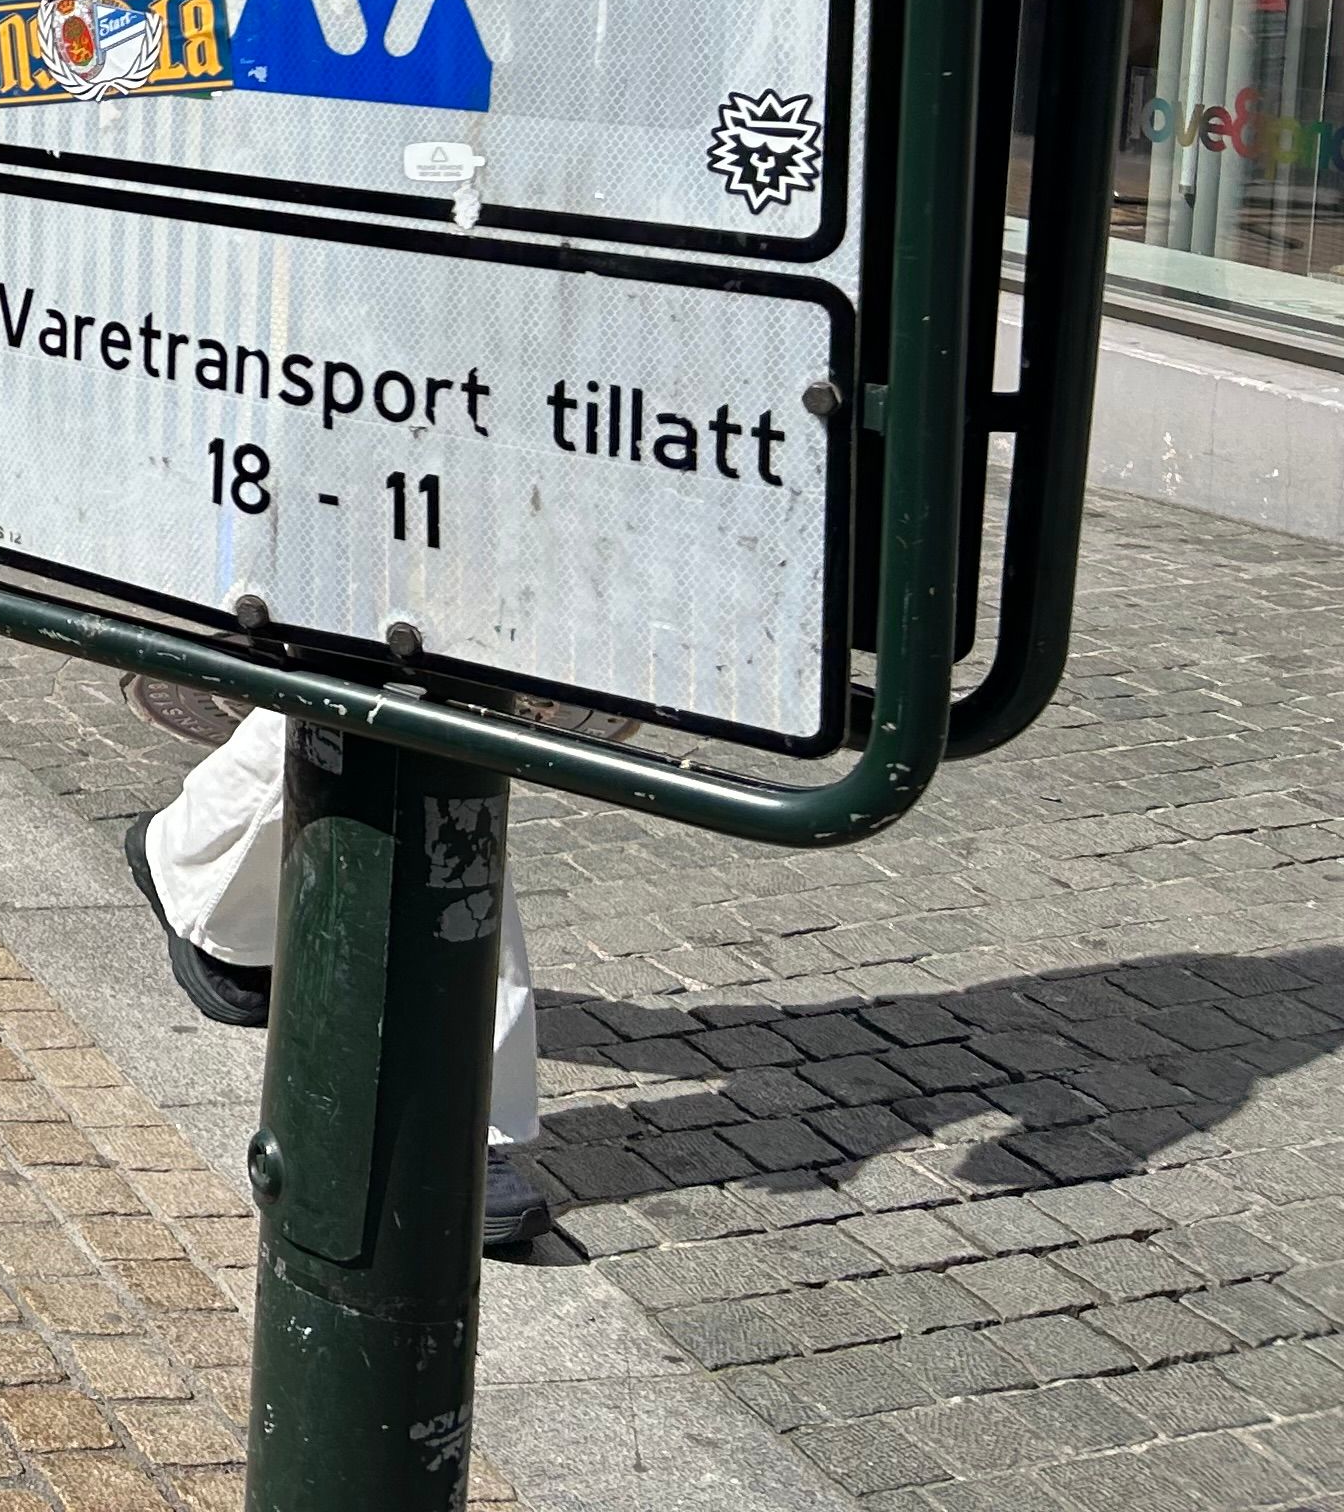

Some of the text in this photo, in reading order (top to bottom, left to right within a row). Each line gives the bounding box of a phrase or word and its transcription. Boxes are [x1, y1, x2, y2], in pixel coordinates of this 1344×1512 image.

[546, 379, 786, 487] tillatt
[207, 437, 441, 549] 18 - 11
